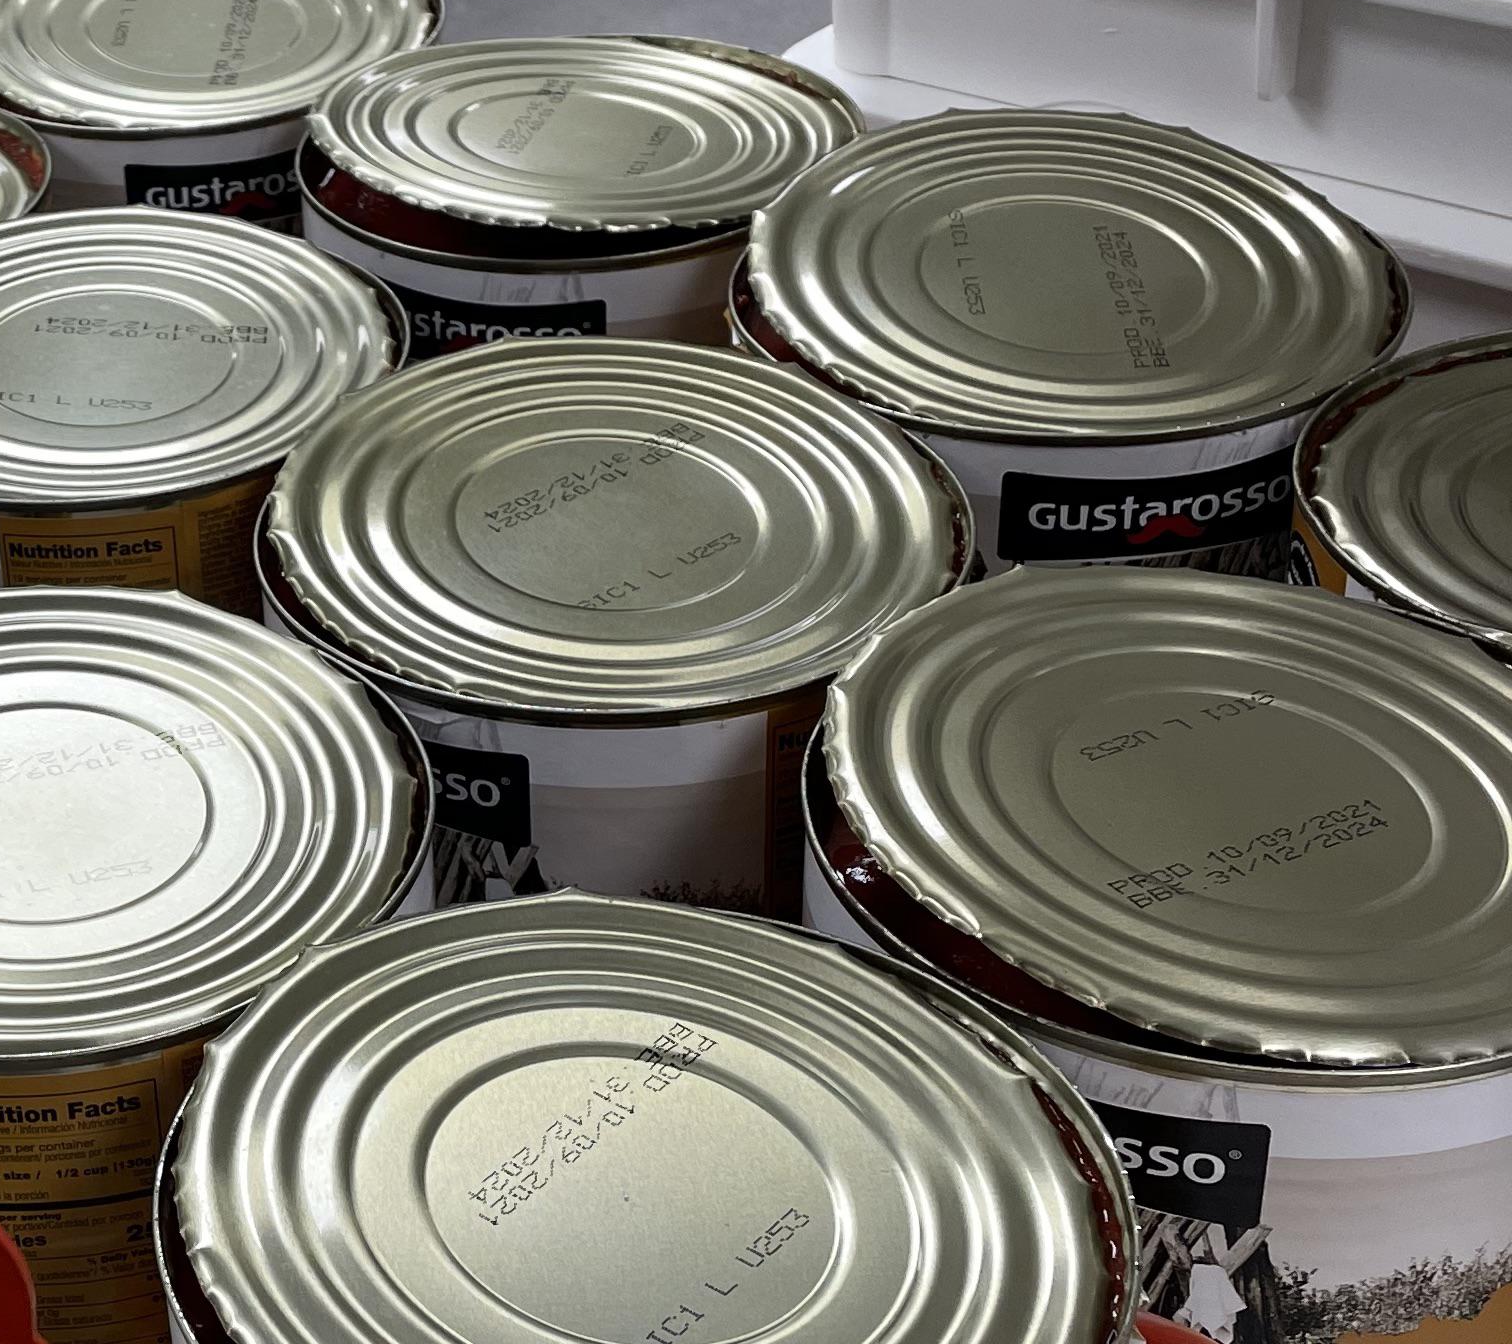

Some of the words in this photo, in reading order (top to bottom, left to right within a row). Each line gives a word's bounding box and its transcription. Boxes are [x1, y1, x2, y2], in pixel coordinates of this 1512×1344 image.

[145, 169, 299, 208] Gustaros
[9, 542, 98, 560] Nutrition
[106, 538, 163, 557] Facts
[1162, 718, 1193, 730] L
[67, 1095, 142, 1120] Facts
[15, 1143, 35, 1154] per
[38, 1138, 96, 1152] container
[3, 1170, 31, 1180] size
[56, 1168, 79, 1179] 1/2
[83, 1165, 109, 1177] cup
[705, 1281, 738, 1296] L
[735, 1208, 809, 1268] U253
